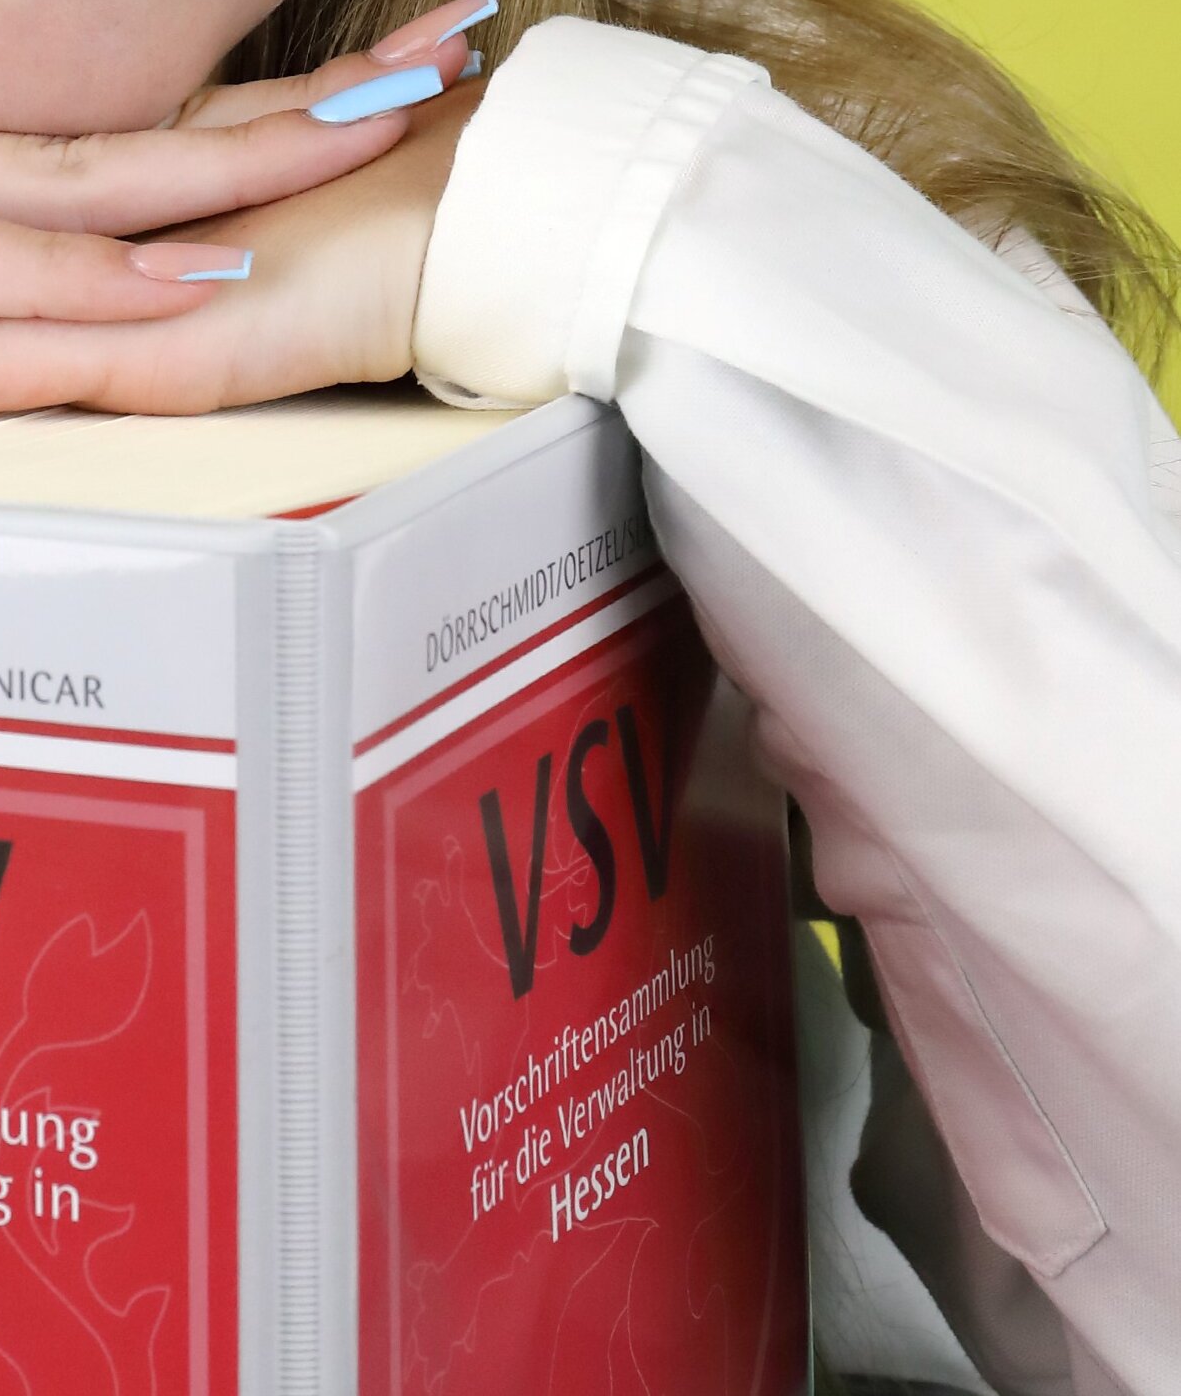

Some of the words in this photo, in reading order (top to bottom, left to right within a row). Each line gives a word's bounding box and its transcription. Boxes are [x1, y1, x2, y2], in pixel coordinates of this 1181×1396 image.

[479, 680, 683, 1000] VSV
[460, 934, 716, 1154] Vorschriftensammlung
[470, 1159, 509, 1221] für
[516, 1125, 552, 1185] die
[558, 1022, 686, 1149] Verwaltung
[692, 1001, 711, 1047] in
[33, 1168, 81, 1222] in
[549, 1127, 650, 1244] Hessen
